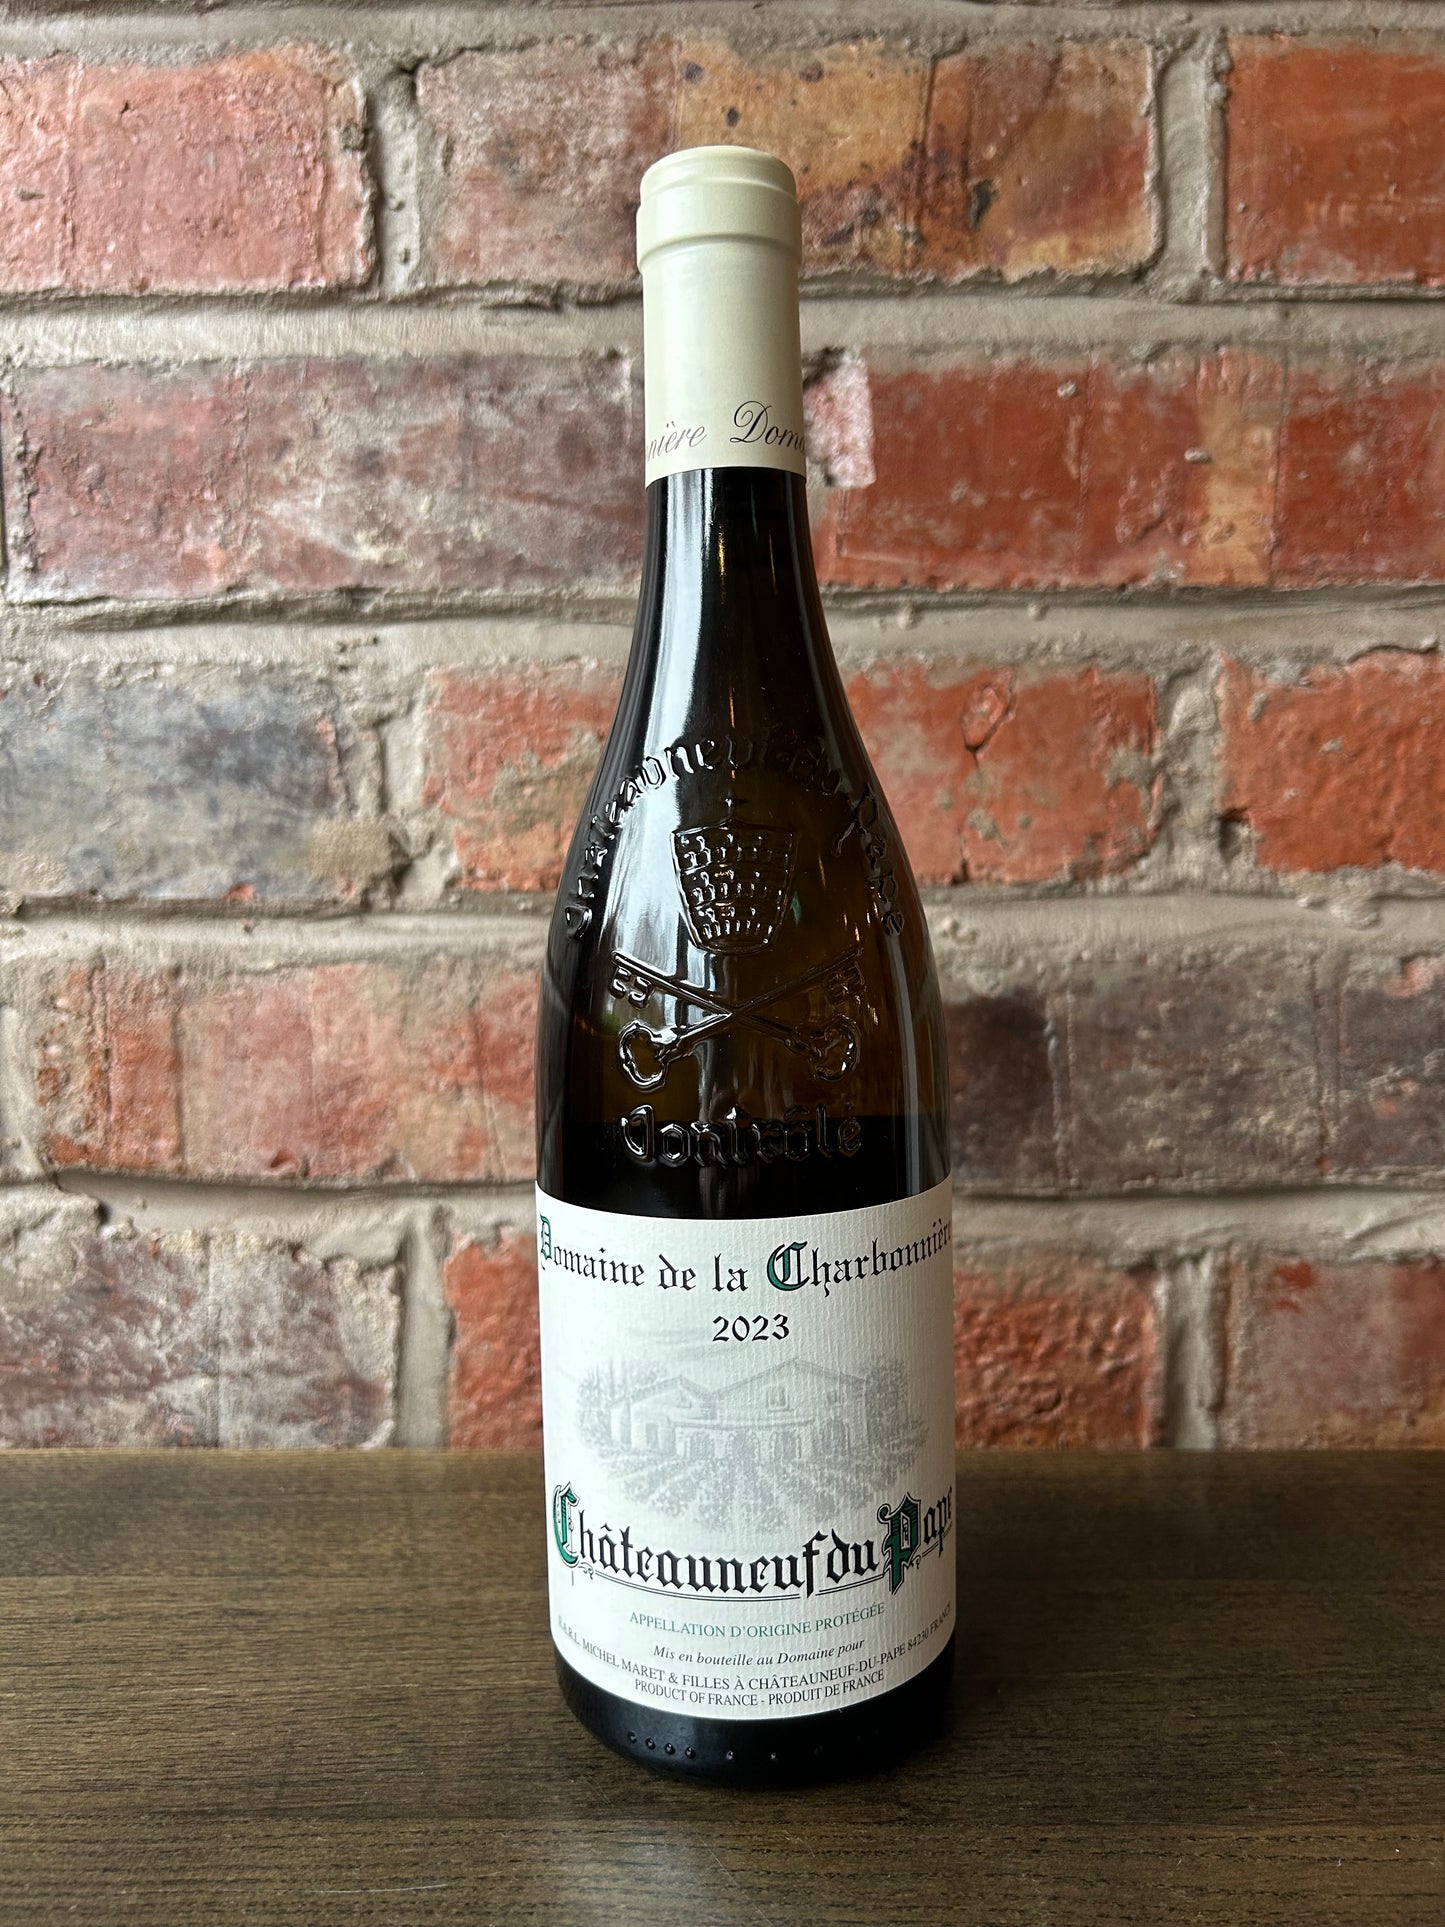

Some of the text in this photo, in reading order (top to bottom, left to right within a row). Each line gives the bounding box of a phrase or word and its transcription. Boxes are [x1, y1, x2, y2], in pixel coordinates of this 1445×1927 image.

[539, 1211, 645, 1287] Domaine
[657, 1254, 697, 1291] de
[712, 1253, 750, 1293] la
[712, 1313, 790, 1341] 2023
[630, 1602, 885, 1638] APPELLATION D'ORIGINE PROTÉGÉE
[582, 1638, 620, 1667] MICHEL
[621, 1658, 665, 1682] MARET
[668, 1672, 679, 1685] &
[682, 1674, 730, 1690] FILLES
[734, 1670, 745, 1690] À
[748, 1643, 906, 1691] CHÂTEAUNEUF-DU-PAPE
[653, 1639, 865, 1666] Mis en bouteille au Domaine pour
[635, 1678, 687, 1702] PRODUCT
[689, 1691, 706, 1704] OF
[708, 1693, 758, 1706] FRANCE
[768, 1687, 823, 1705] PRODUIT
[825, 1683, 840, 1698] DE
[842, 1668, 885, 1693] FRANCE
